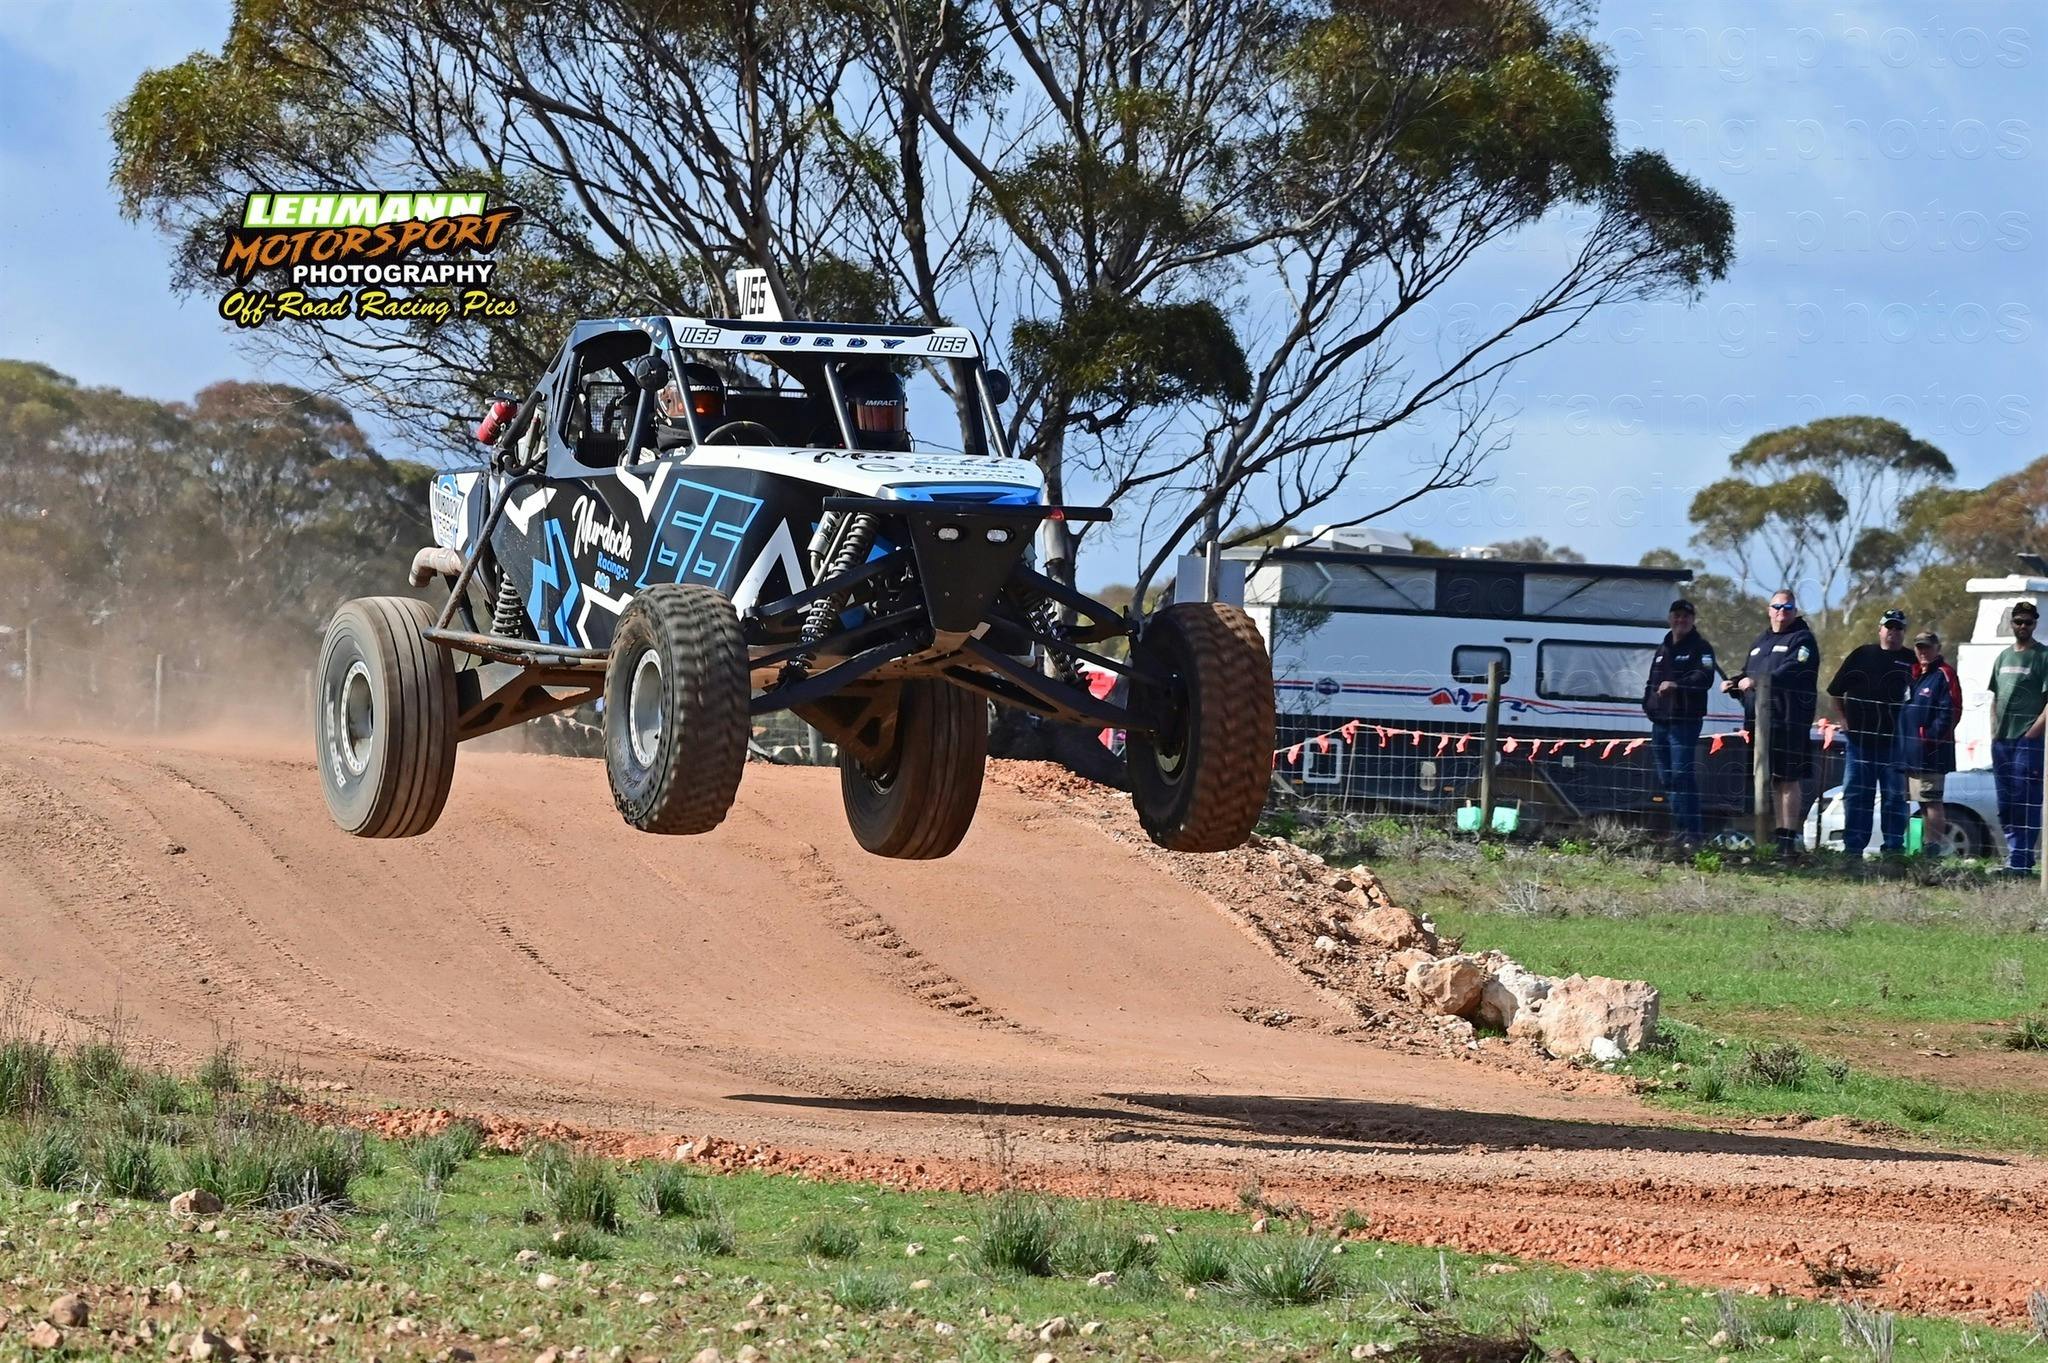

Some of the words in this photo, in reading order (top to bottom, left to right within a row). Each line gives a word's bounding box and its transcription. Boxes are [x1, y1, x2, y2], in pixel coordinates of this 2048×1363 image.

[742, 276, 767, 315] 1166
[679, 326, 722, 345] 1166
[741, 333, 905, 349] MURDY
[927, 335, 968, 353] 1166
[865, 399, 898, 407] IMPACT
[572, 495, 632, 561] Murdock
[597, 551, 621, 581] Racing
